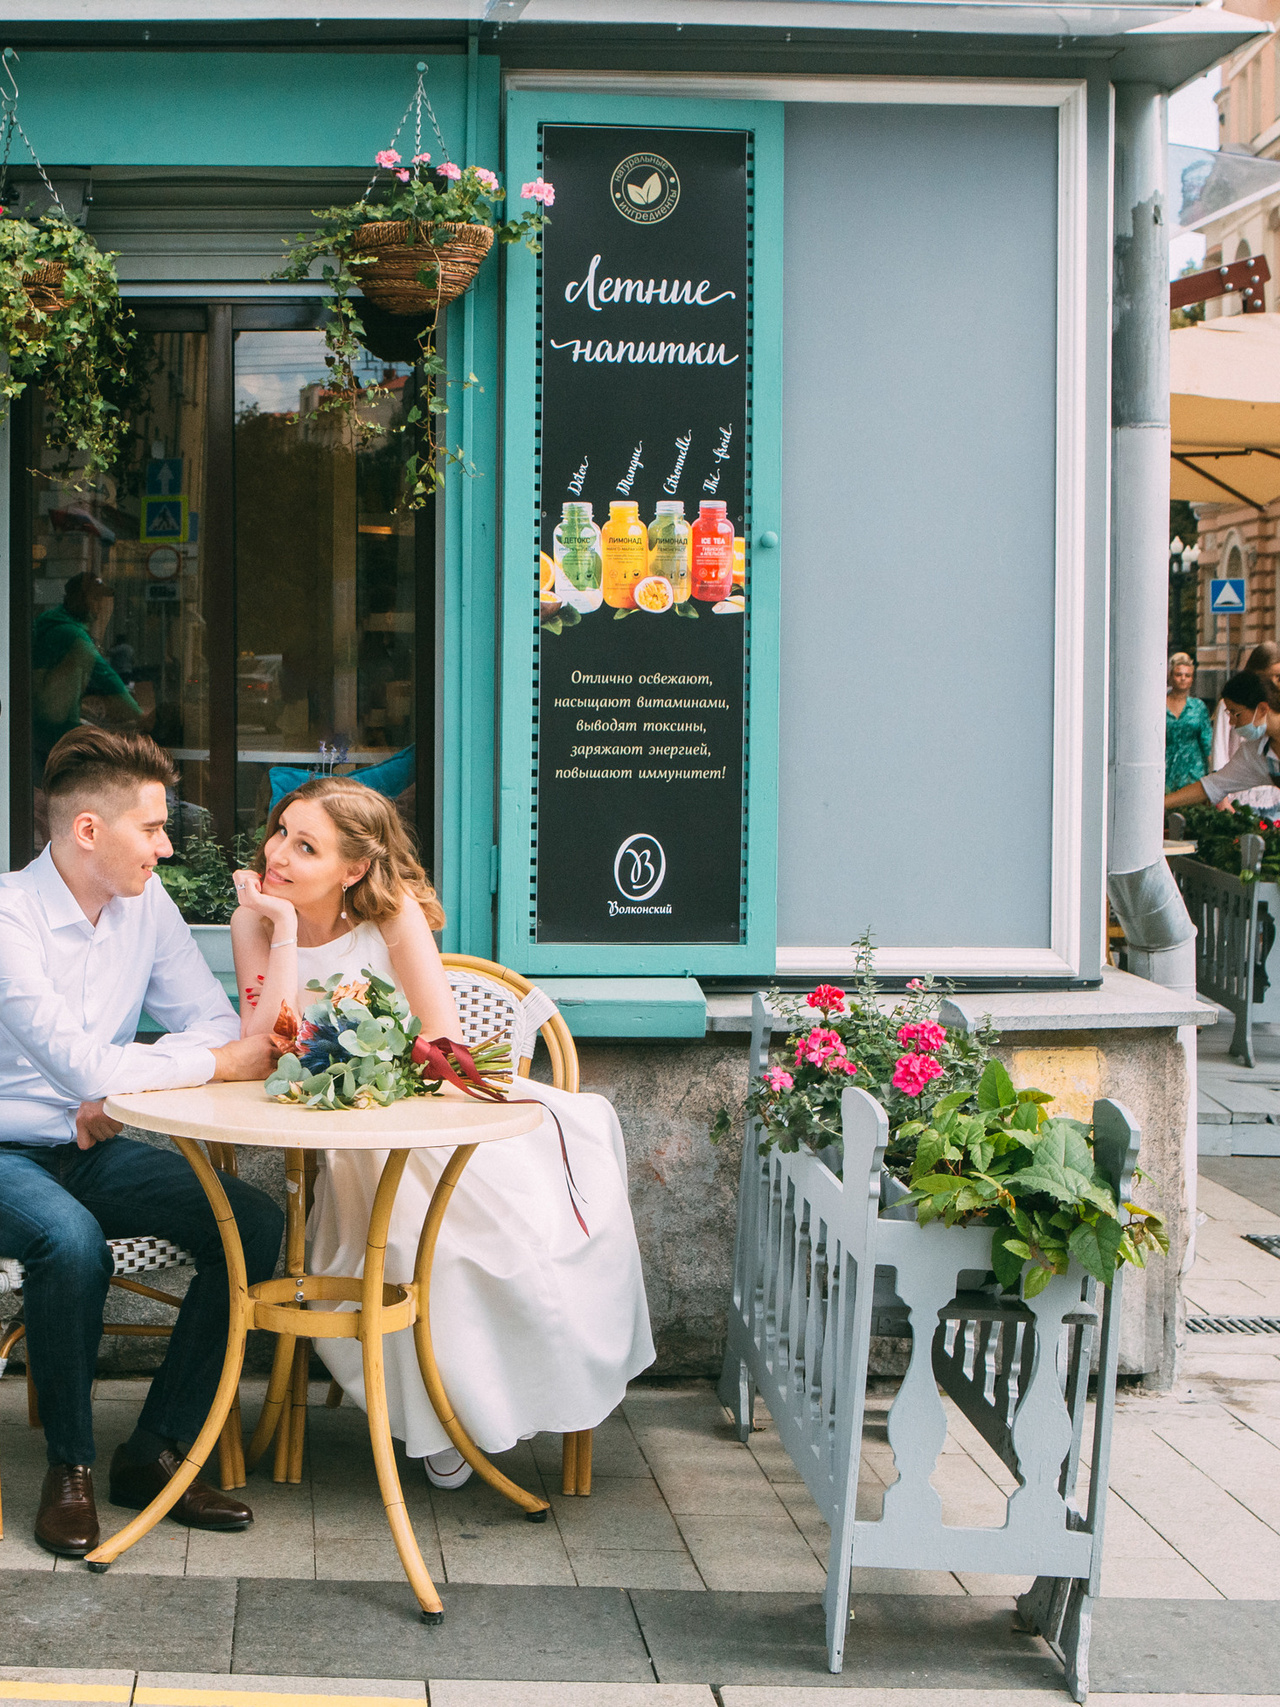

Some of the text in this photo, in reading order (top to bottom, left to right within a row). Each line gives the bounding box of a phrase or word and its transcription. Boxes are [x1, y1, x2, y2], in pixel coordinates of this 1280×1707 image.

[614, 155, 669, 182] натуральные
[618, 189, 678, 222] ингредиенты
[565, 254, 736, 311] Летние
[550, 339, 739, 366] напитки
[712, 423, 732, 464] froid
[616, 440, 644, 496] Mangue
[662, 429, 692, 495] Citronnelle
[608, 537, 642, 545] ЛИМОНАД
[701, 537, 726, 545] ICE TEA
[571, 670, 713, 687] Отлично освежают,
[554, 696, 730, 711] насыщают витаминами,
[576, 718, 707, 734] выводят токсины,
[570, 743, 712, 759] заряжают энергией,
[555, 766, 726, 783] повышают иммунитет!
[607, 901, 672, 917] Волконский
